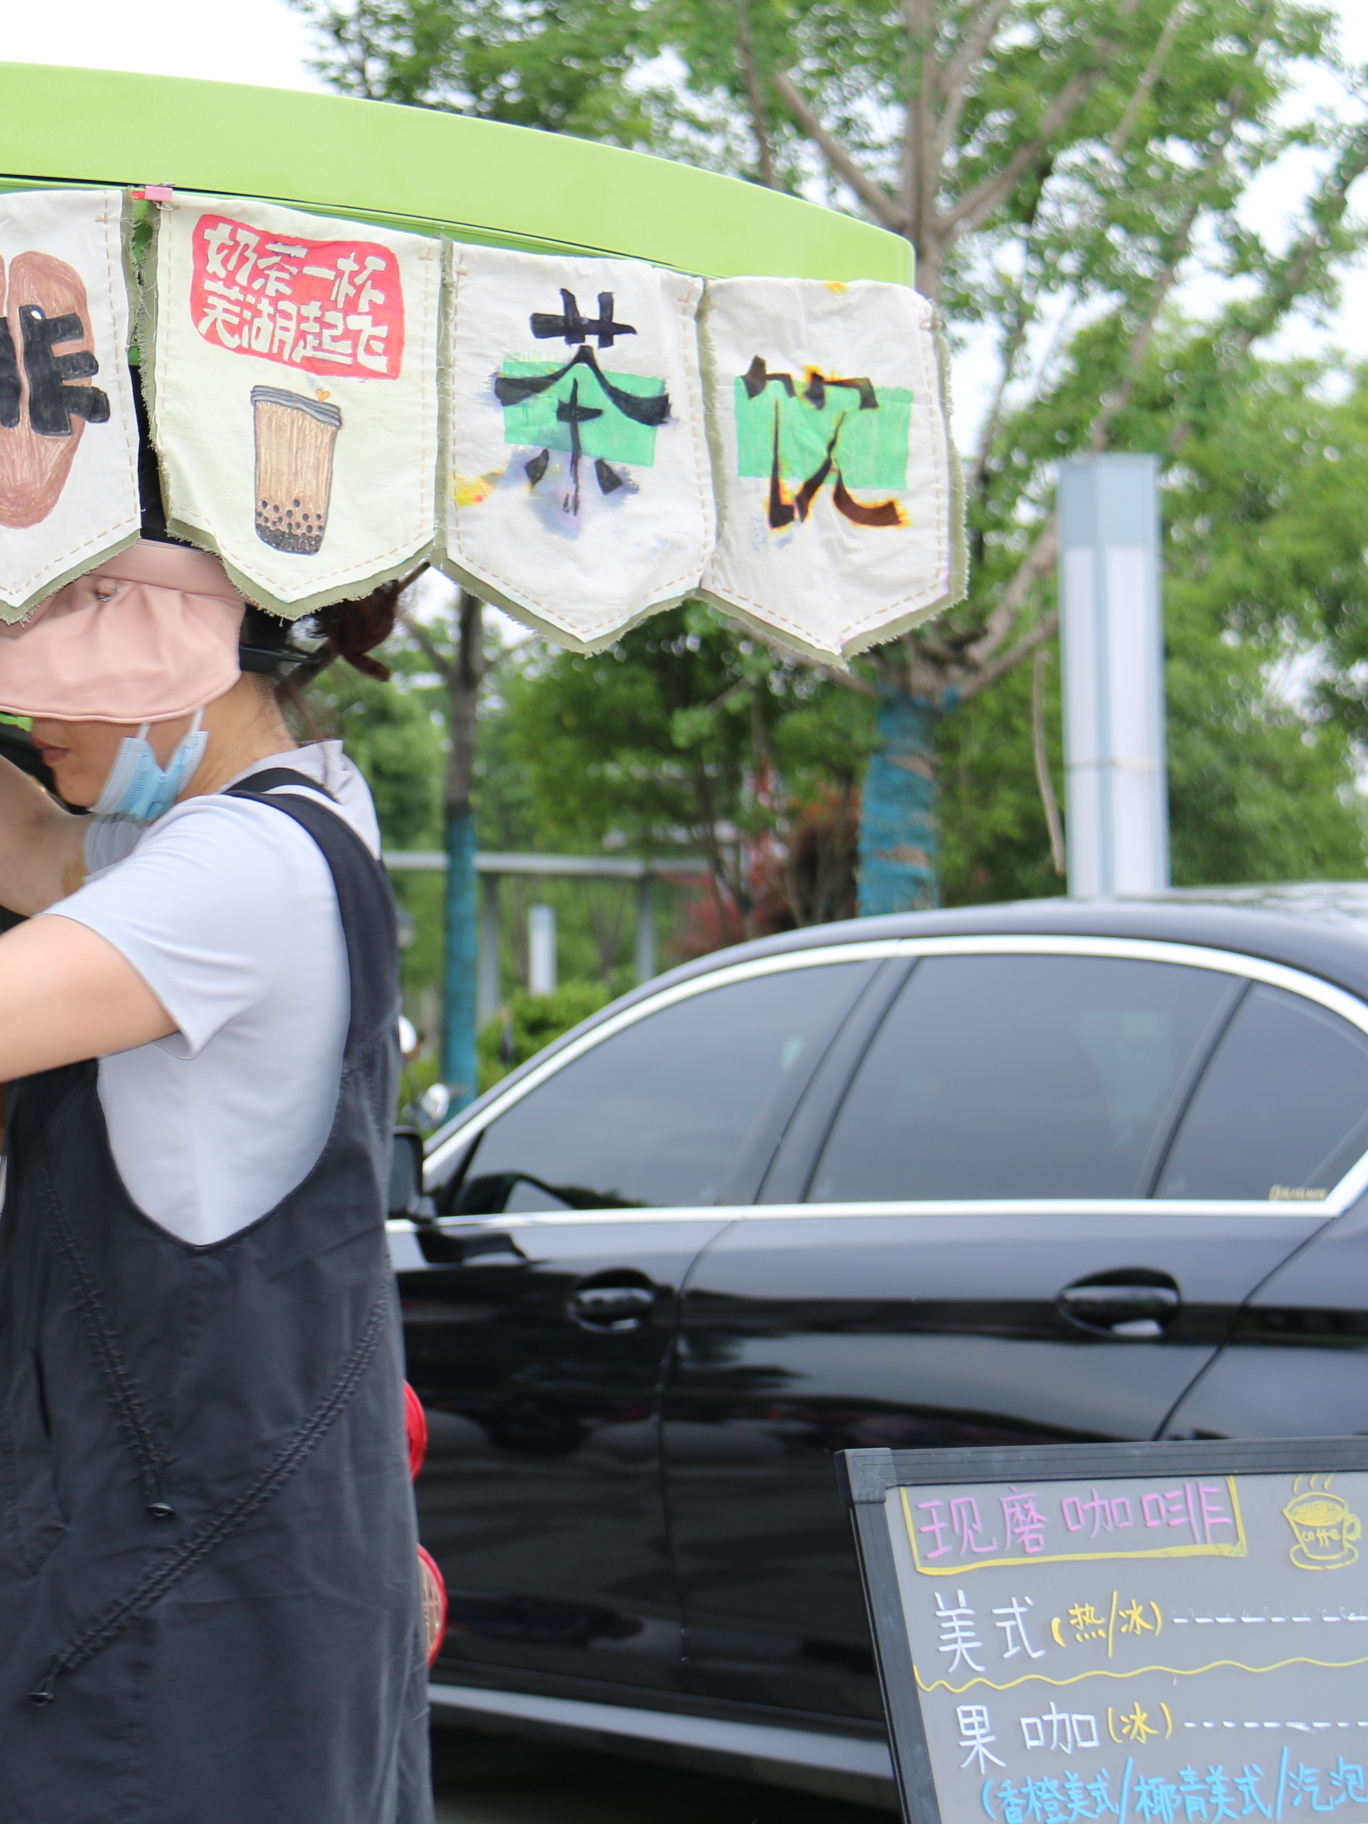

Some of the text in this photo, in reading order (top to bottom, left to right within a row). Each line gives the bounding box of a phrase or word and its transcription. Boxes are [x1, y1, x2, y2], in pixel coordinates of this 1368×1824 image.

[202, 220, 388, 312] 奶茶一杯
[198, 279, 390, 378] 芜湖起飞
[493, 287, 908, 530] 茶 饮
[915, 1481, 1235, 1559] 现磨咖啡
